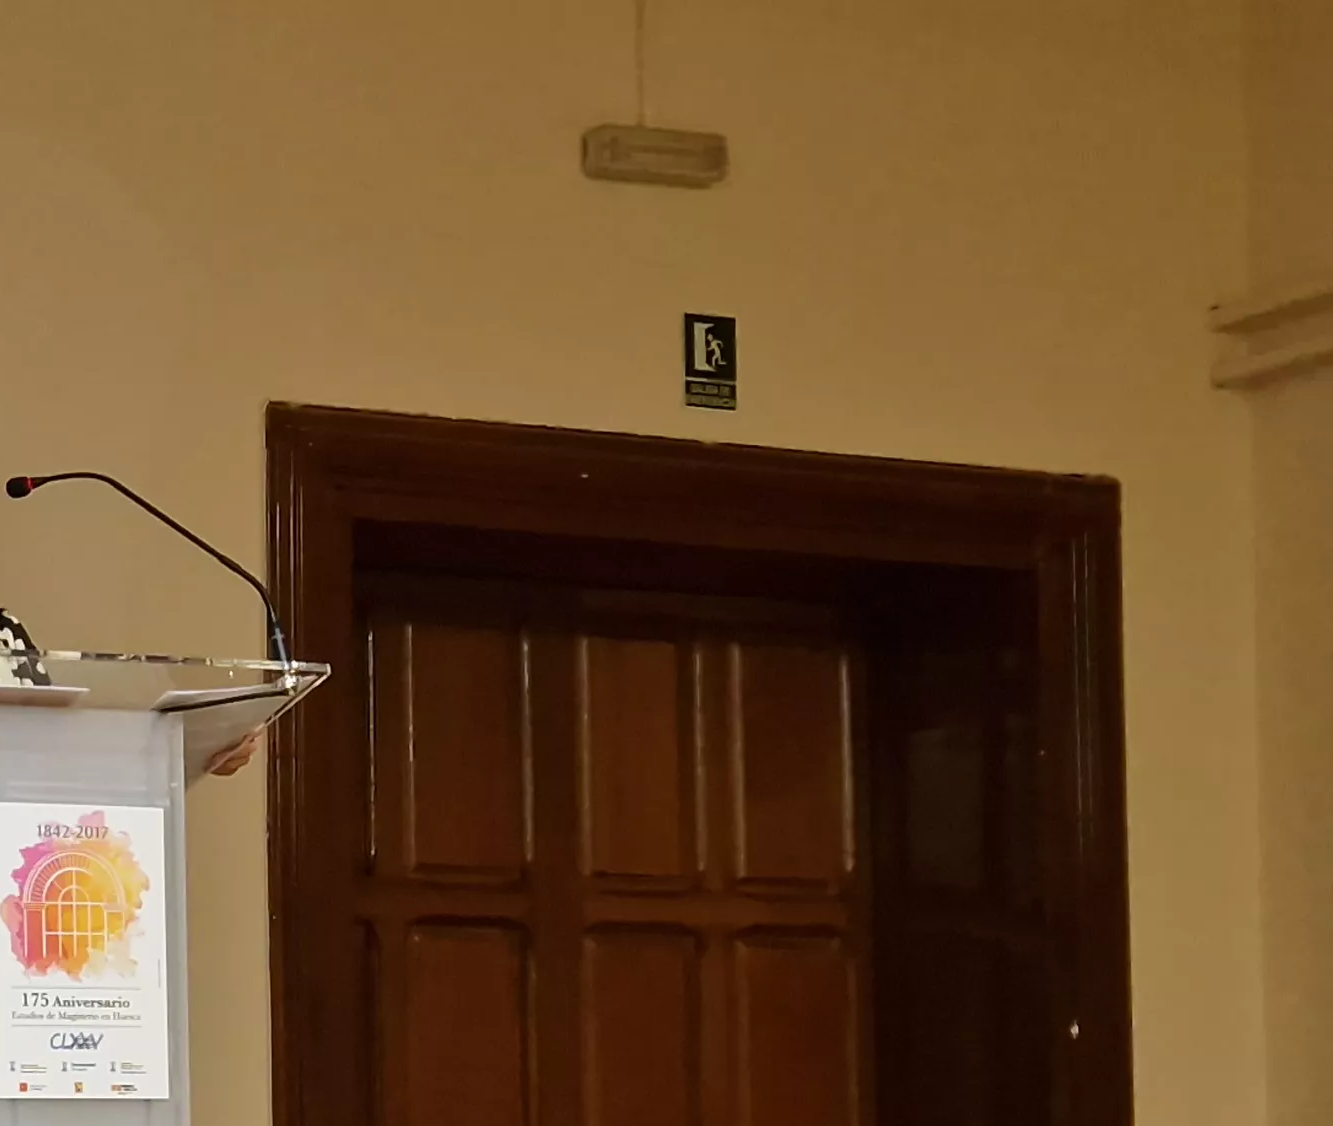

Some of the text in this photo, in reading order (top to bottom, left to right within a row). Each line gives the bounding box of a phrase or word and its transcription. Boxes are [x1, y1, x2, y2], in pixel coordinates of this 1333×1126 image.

[36, 824, 109, 840] 1842-2017
[21, 992, 131, 1009] 175 Aniversario
